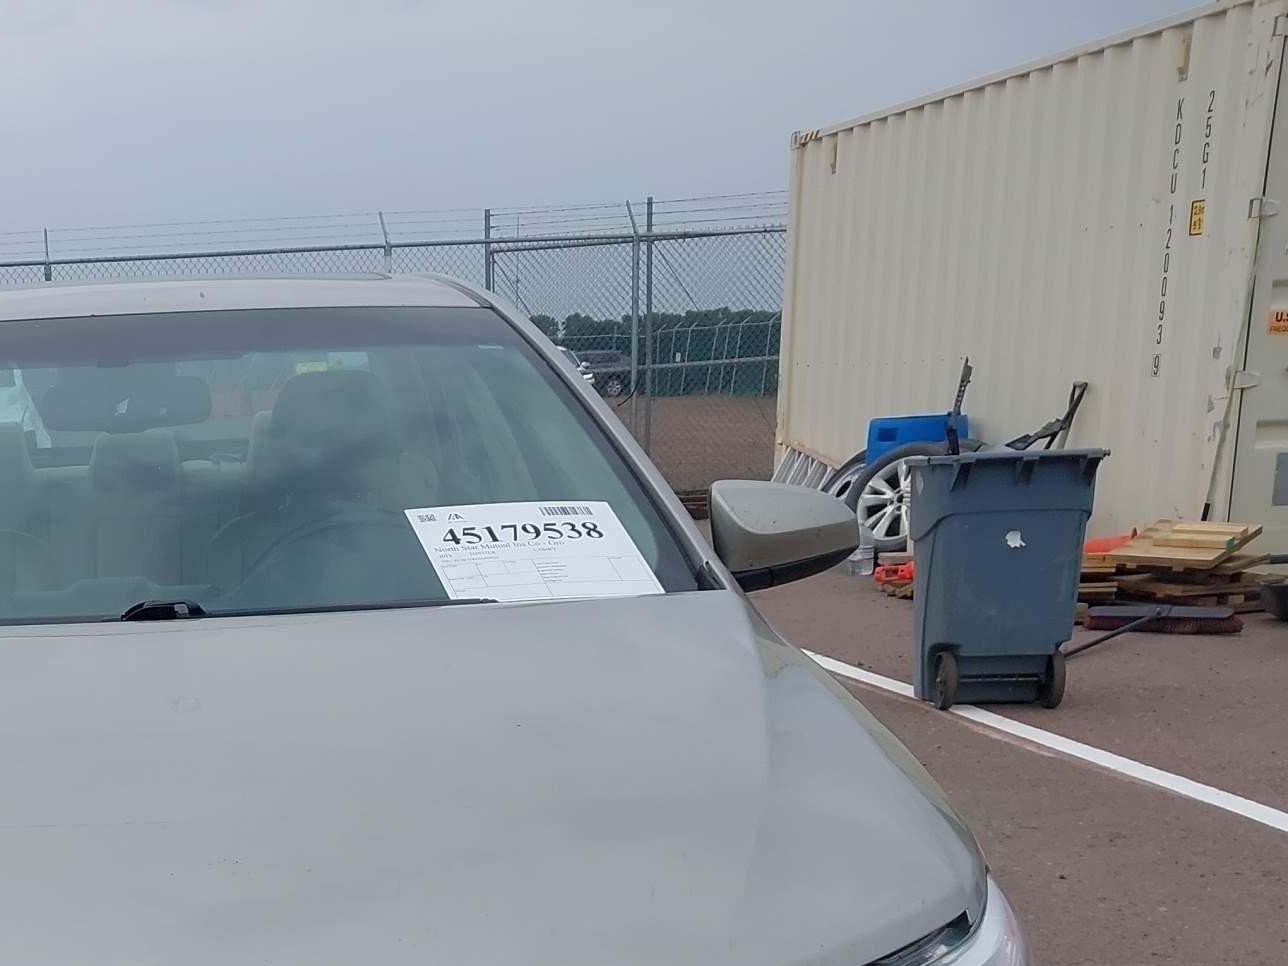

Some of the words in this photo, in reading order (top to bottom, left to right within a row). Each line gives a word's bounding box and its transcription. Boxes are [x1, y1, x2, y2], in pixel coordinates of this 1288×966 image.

[1201, 90, 1216, 189] 25G1
[1156, 204, 1174, 345] 120093
[434, 545, 460, 553] North
[442, 521, 604, 545] 45179538
